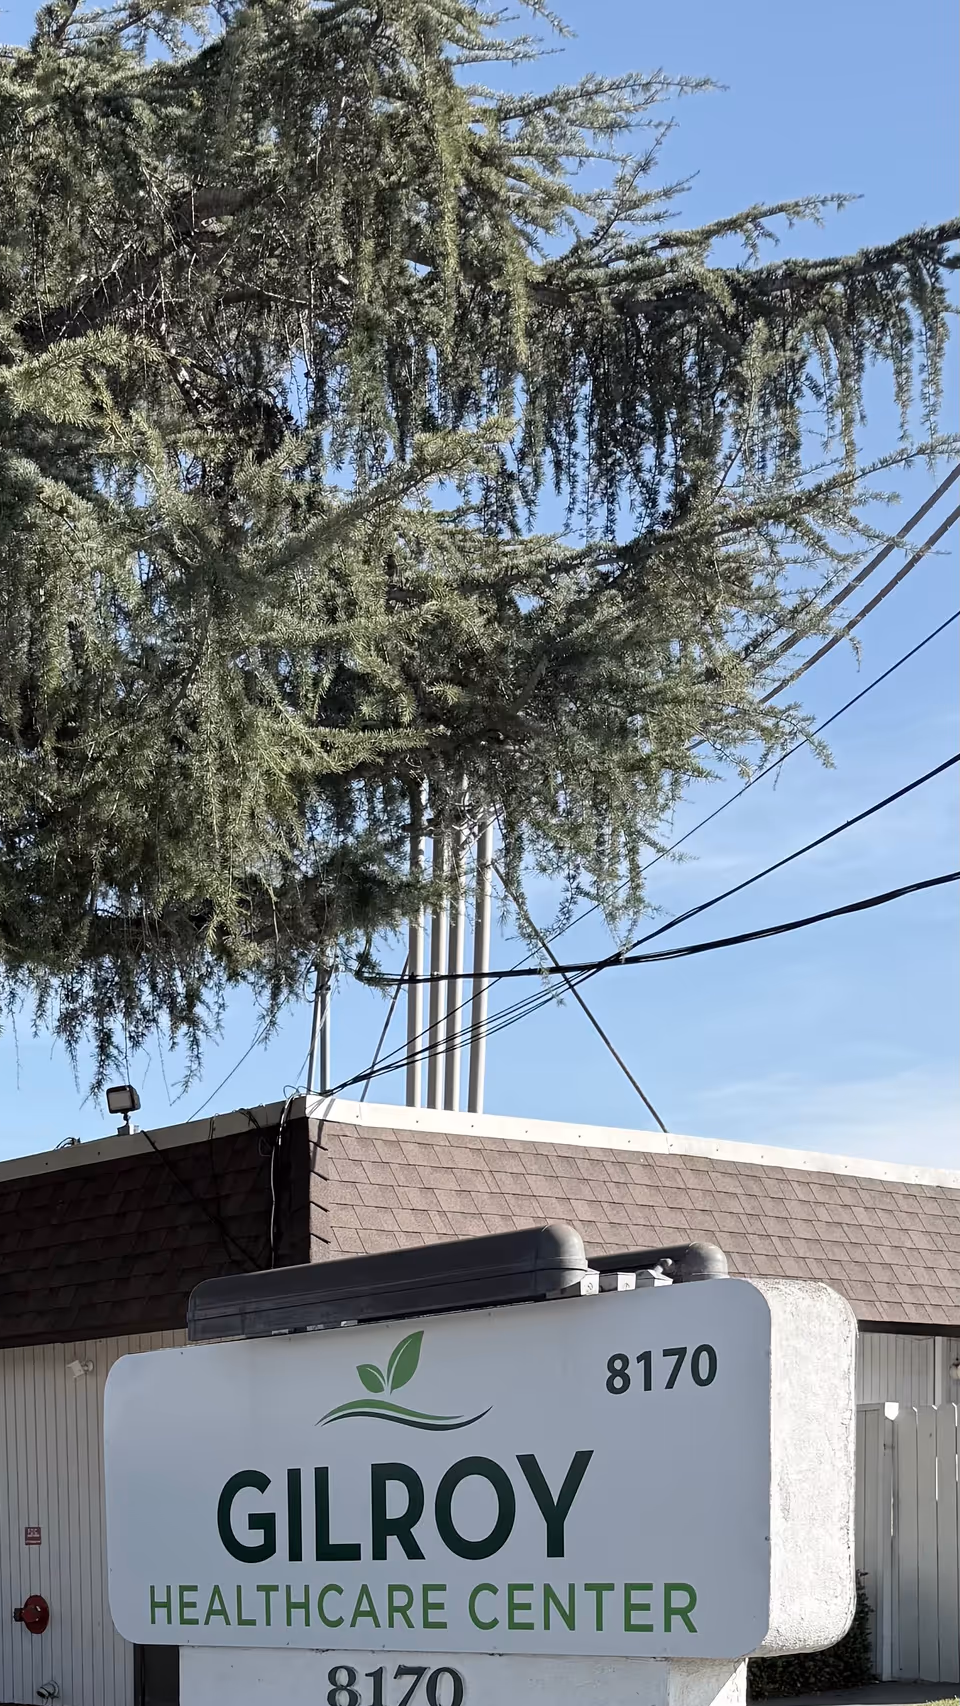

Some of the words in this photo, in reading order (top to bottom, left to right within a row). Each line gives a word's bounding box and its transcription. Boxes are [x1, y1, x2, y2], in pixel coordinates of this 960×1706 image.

[605, 1343, 719, 1395] 8170
[216, 1449, 596, 1564] GILROY
[149, 1582, 448, 1630] HEALTHCARE
[468, 1582, 699, 1634] CENTER
